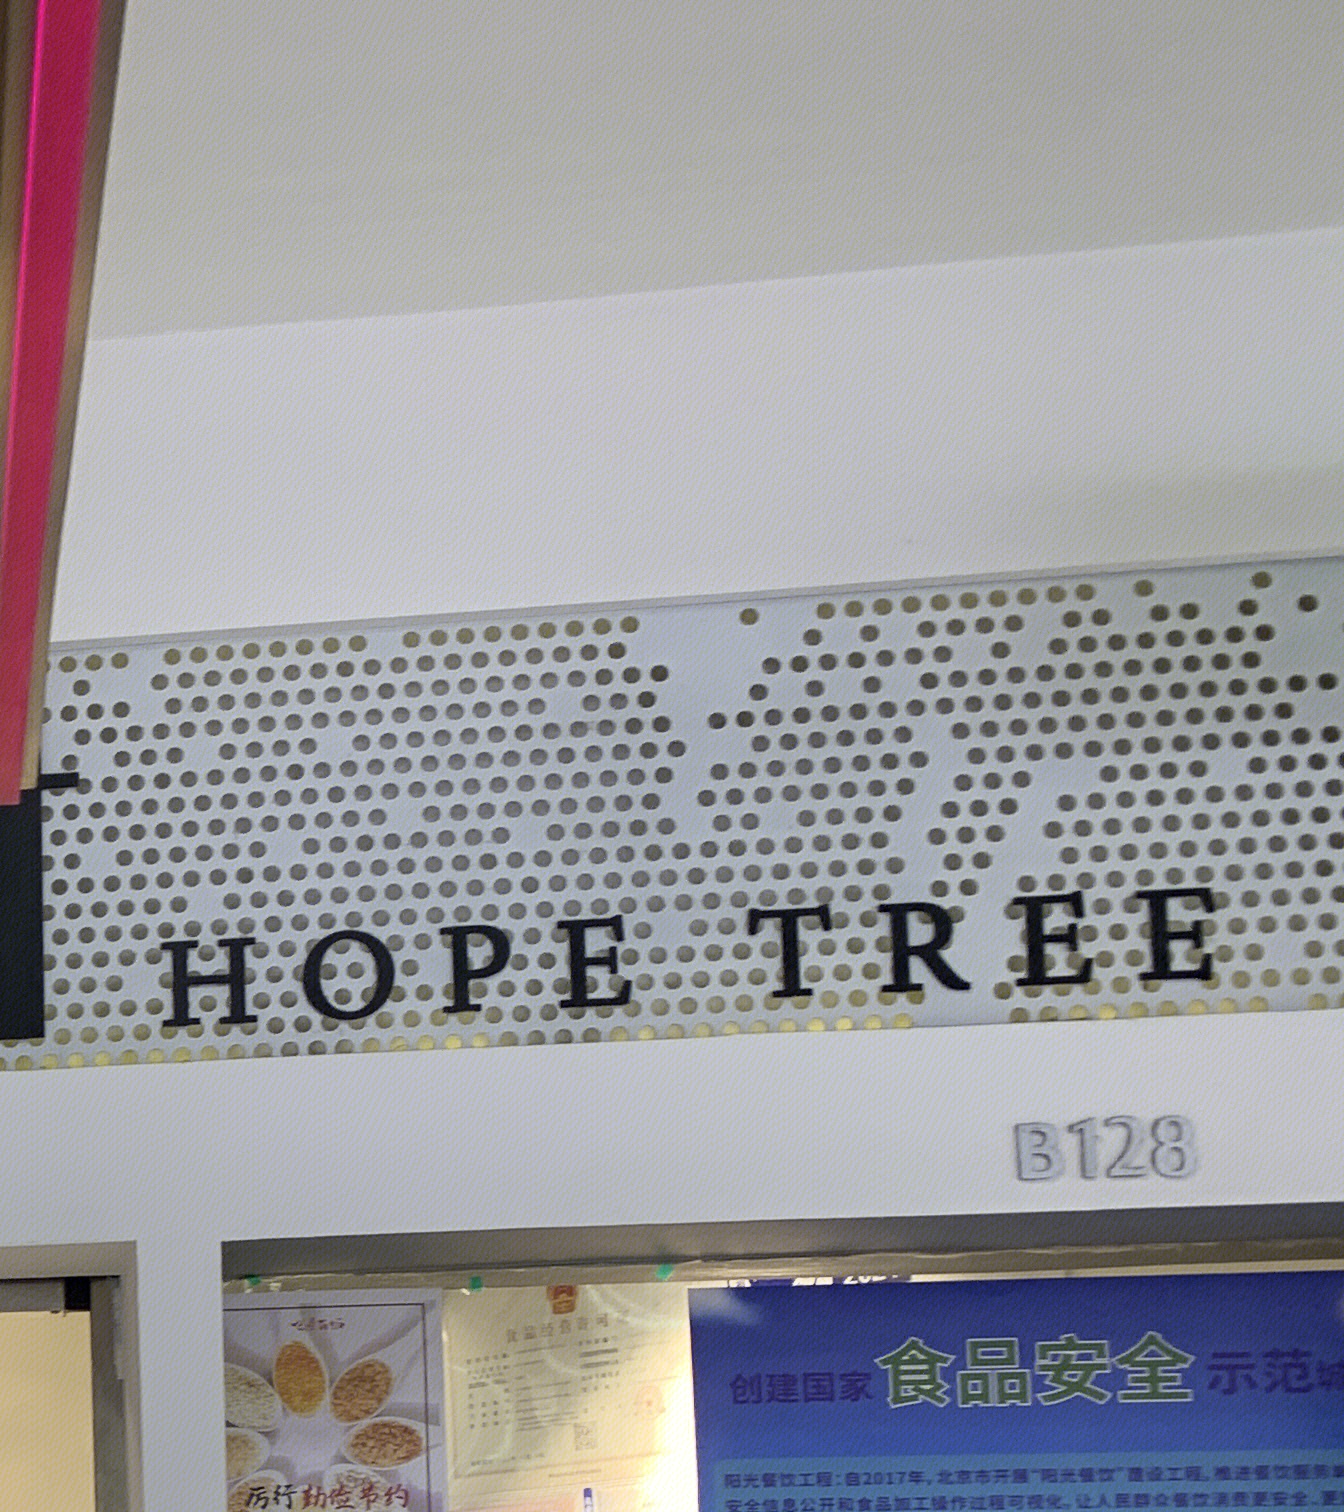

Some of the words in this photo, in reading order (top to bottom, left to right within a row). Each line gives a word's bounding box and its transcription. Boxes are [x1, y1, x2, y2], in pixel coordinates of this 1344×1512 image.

[160, 915, 633, 1029] HOPE
[747, 888, 1215, 998] TREE
[1013, 1114, 1200, 1183] B128
[729, 1371, 872, 1405] 创建国家
[874, 1331, 1195, 1409] 食品安全
